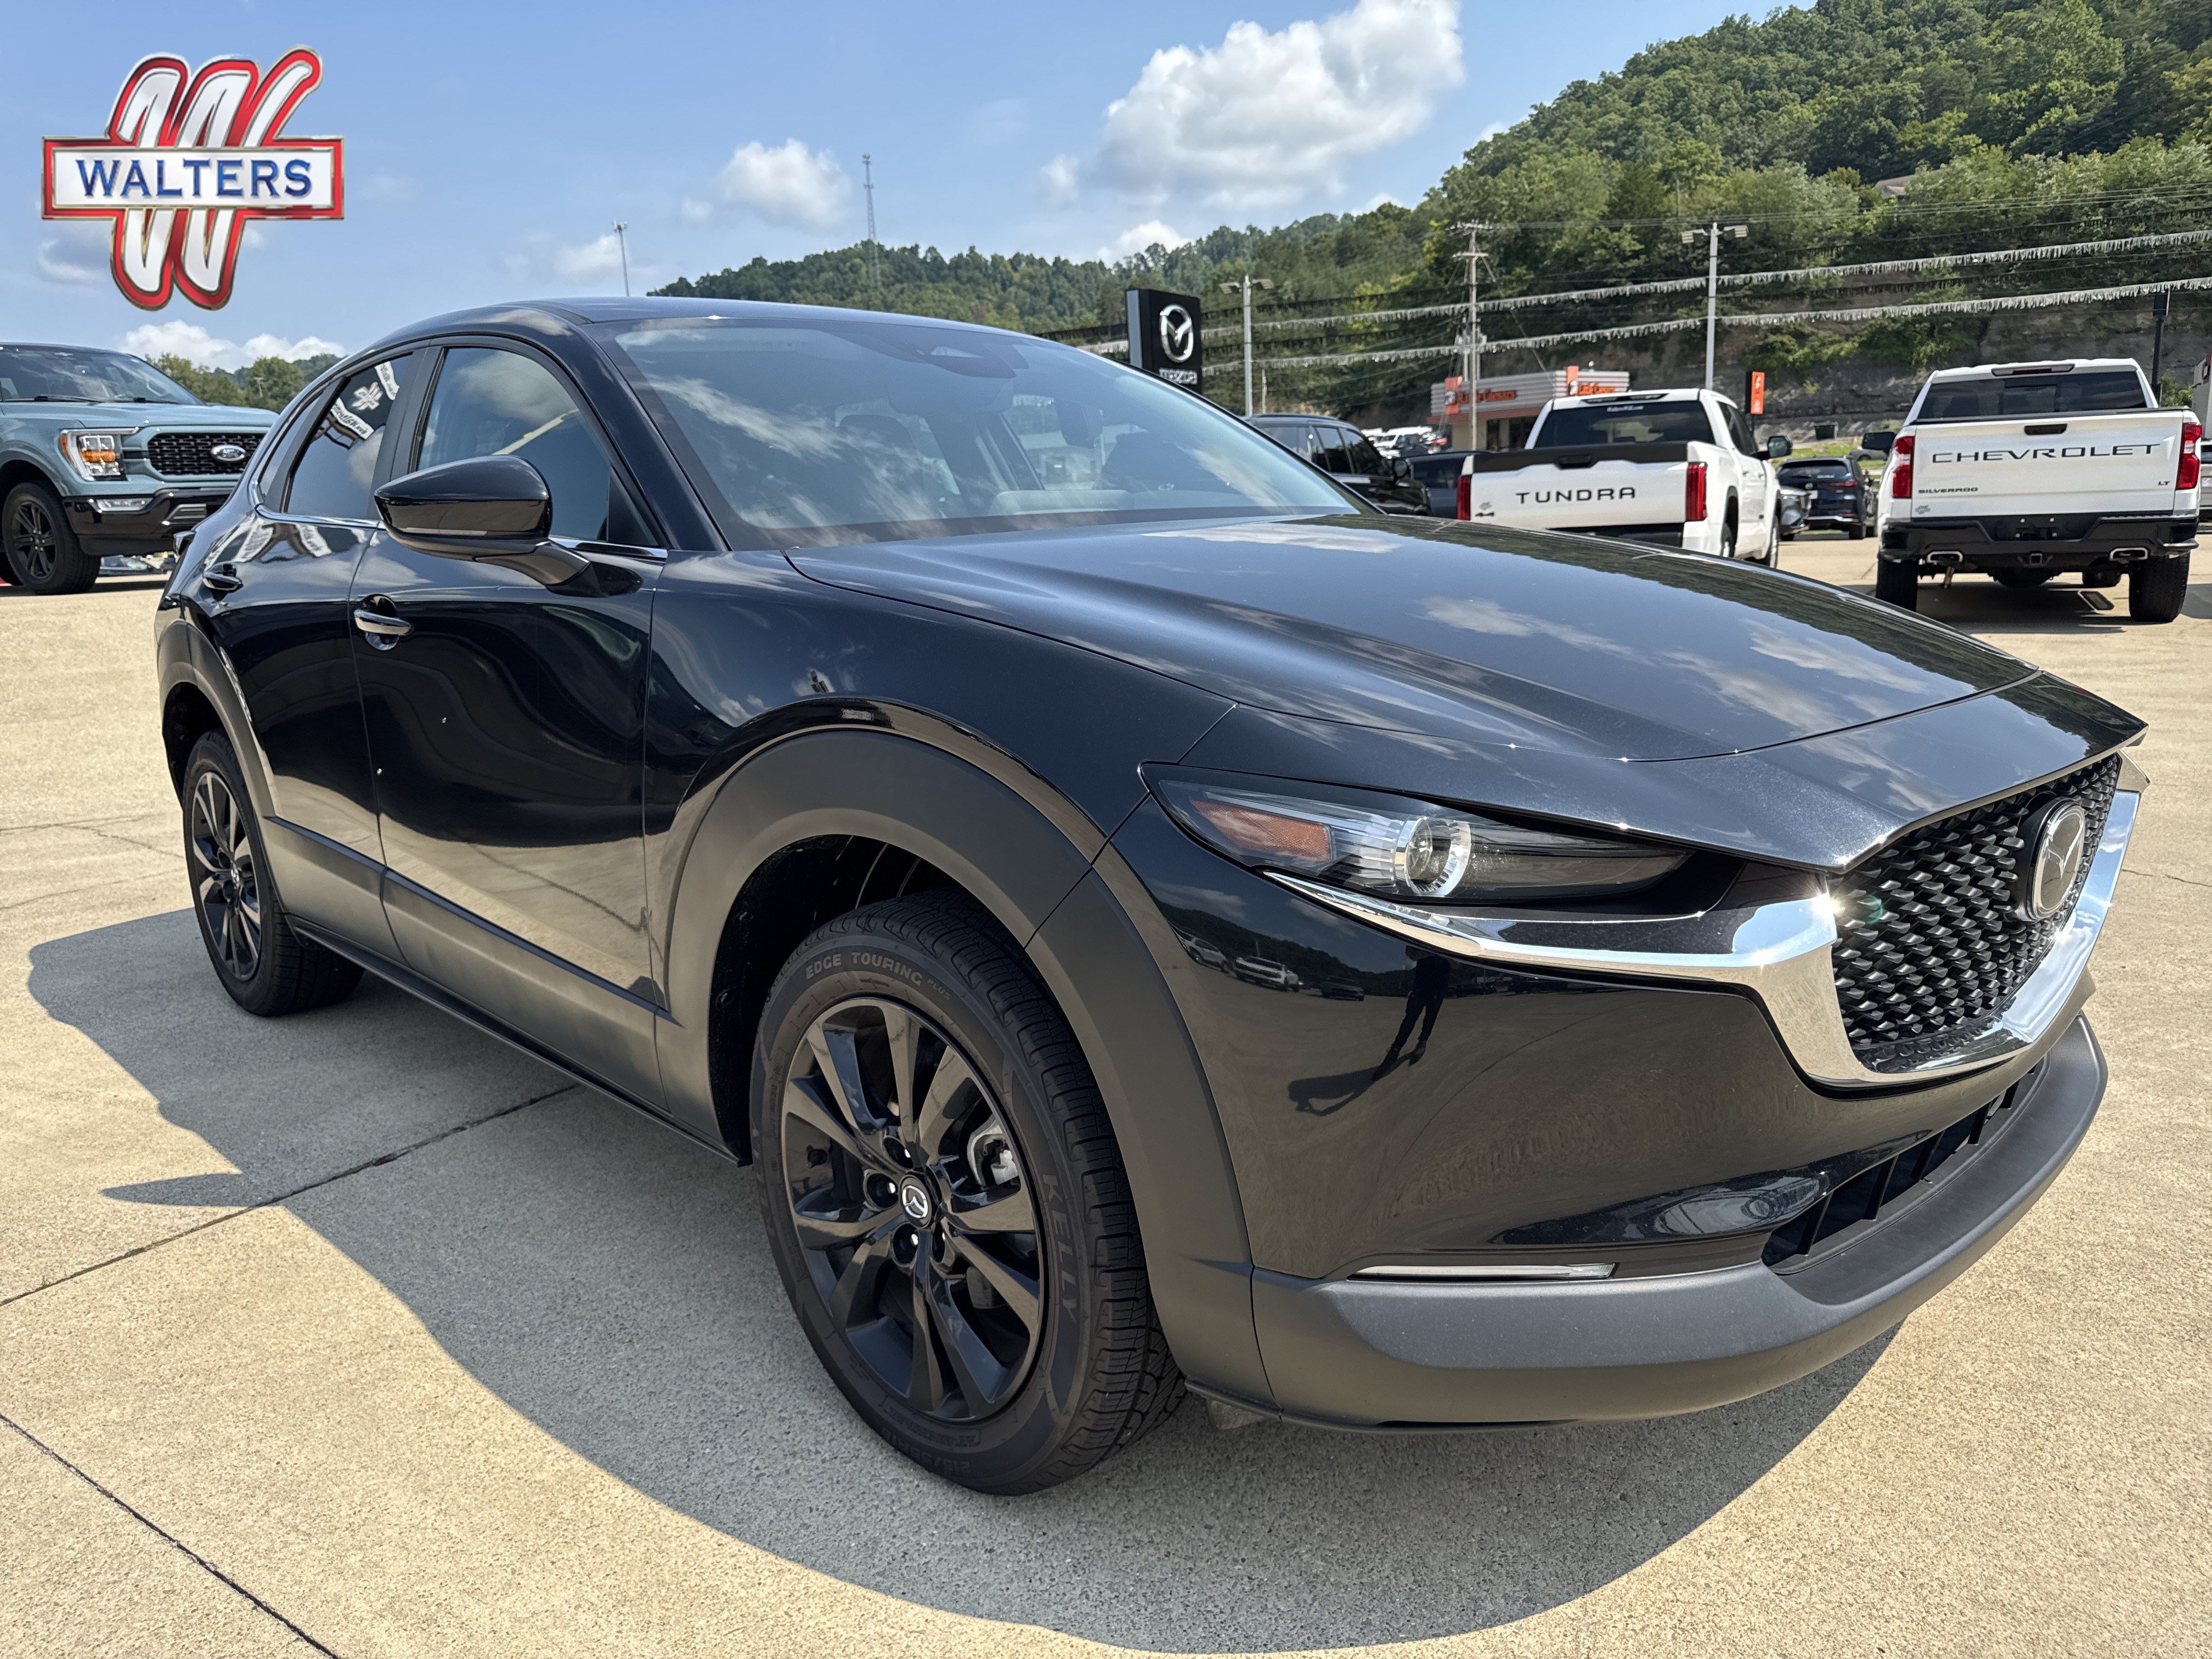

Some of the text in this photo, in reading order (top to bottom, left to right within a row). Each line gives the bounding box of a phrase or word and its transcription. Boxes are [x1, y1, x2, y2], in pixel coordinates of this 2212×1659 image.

[1932, 443, 2160, 463] CHEVROLET
[1515, 487, 1635, 504] TUNDRA
[805, 952, 952, 1001] EDGE TOURING PLUS
[1042, 1173, 1077, 1325] KELLY
